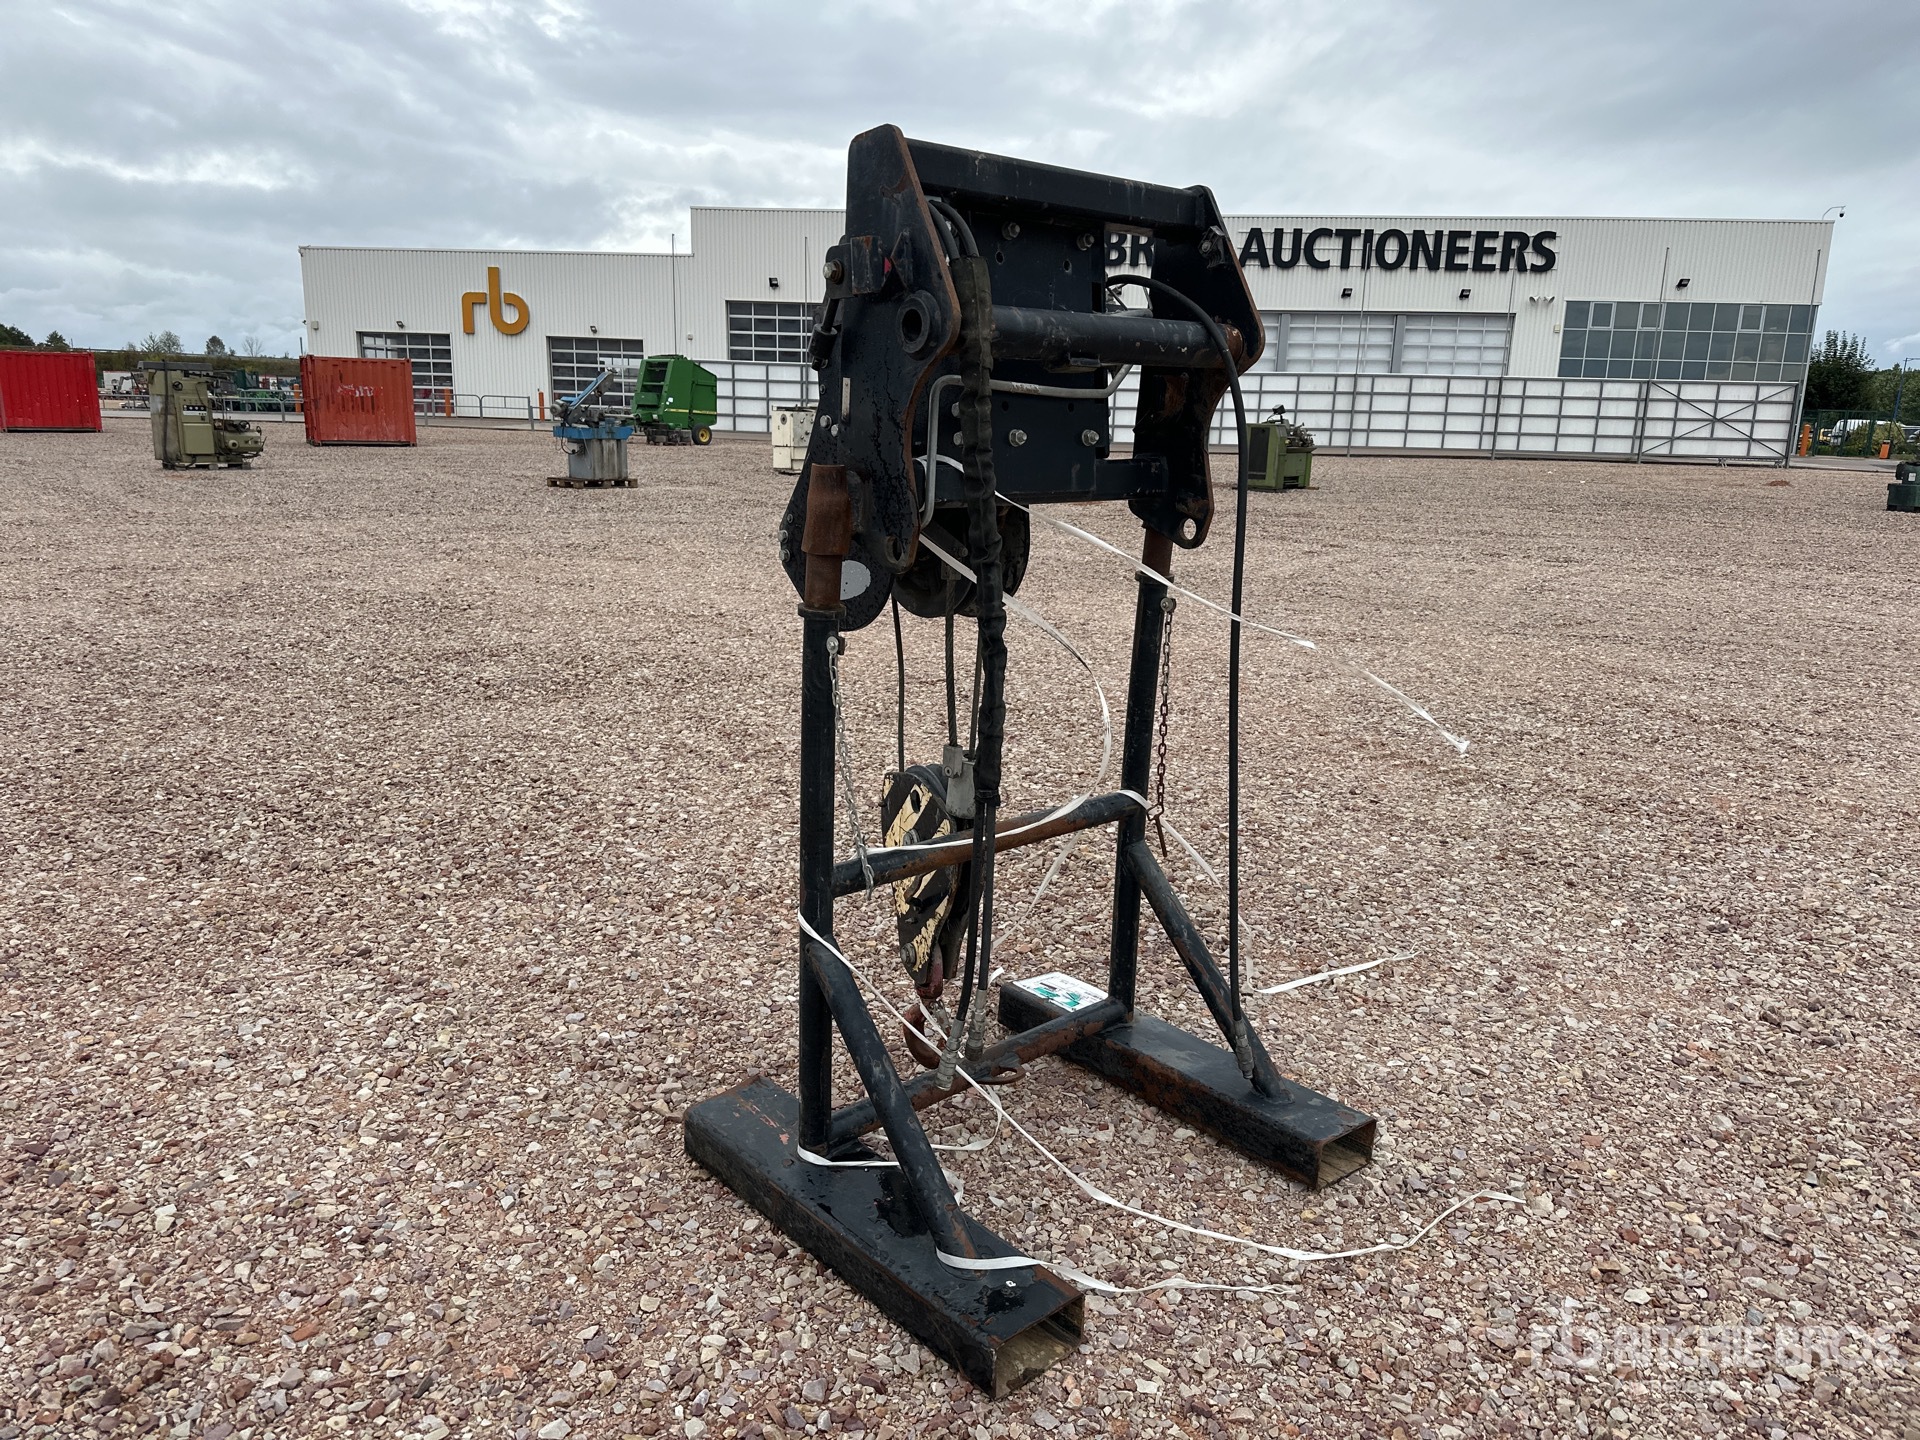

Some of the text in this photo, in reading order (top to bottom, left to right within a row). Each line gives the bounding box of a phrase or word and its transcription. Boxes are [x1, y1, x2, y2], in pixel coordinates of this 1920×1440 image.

[1104, 227, 1557, 273] BR AUCTIONEERS
[461, 266, 530, 335] rb
